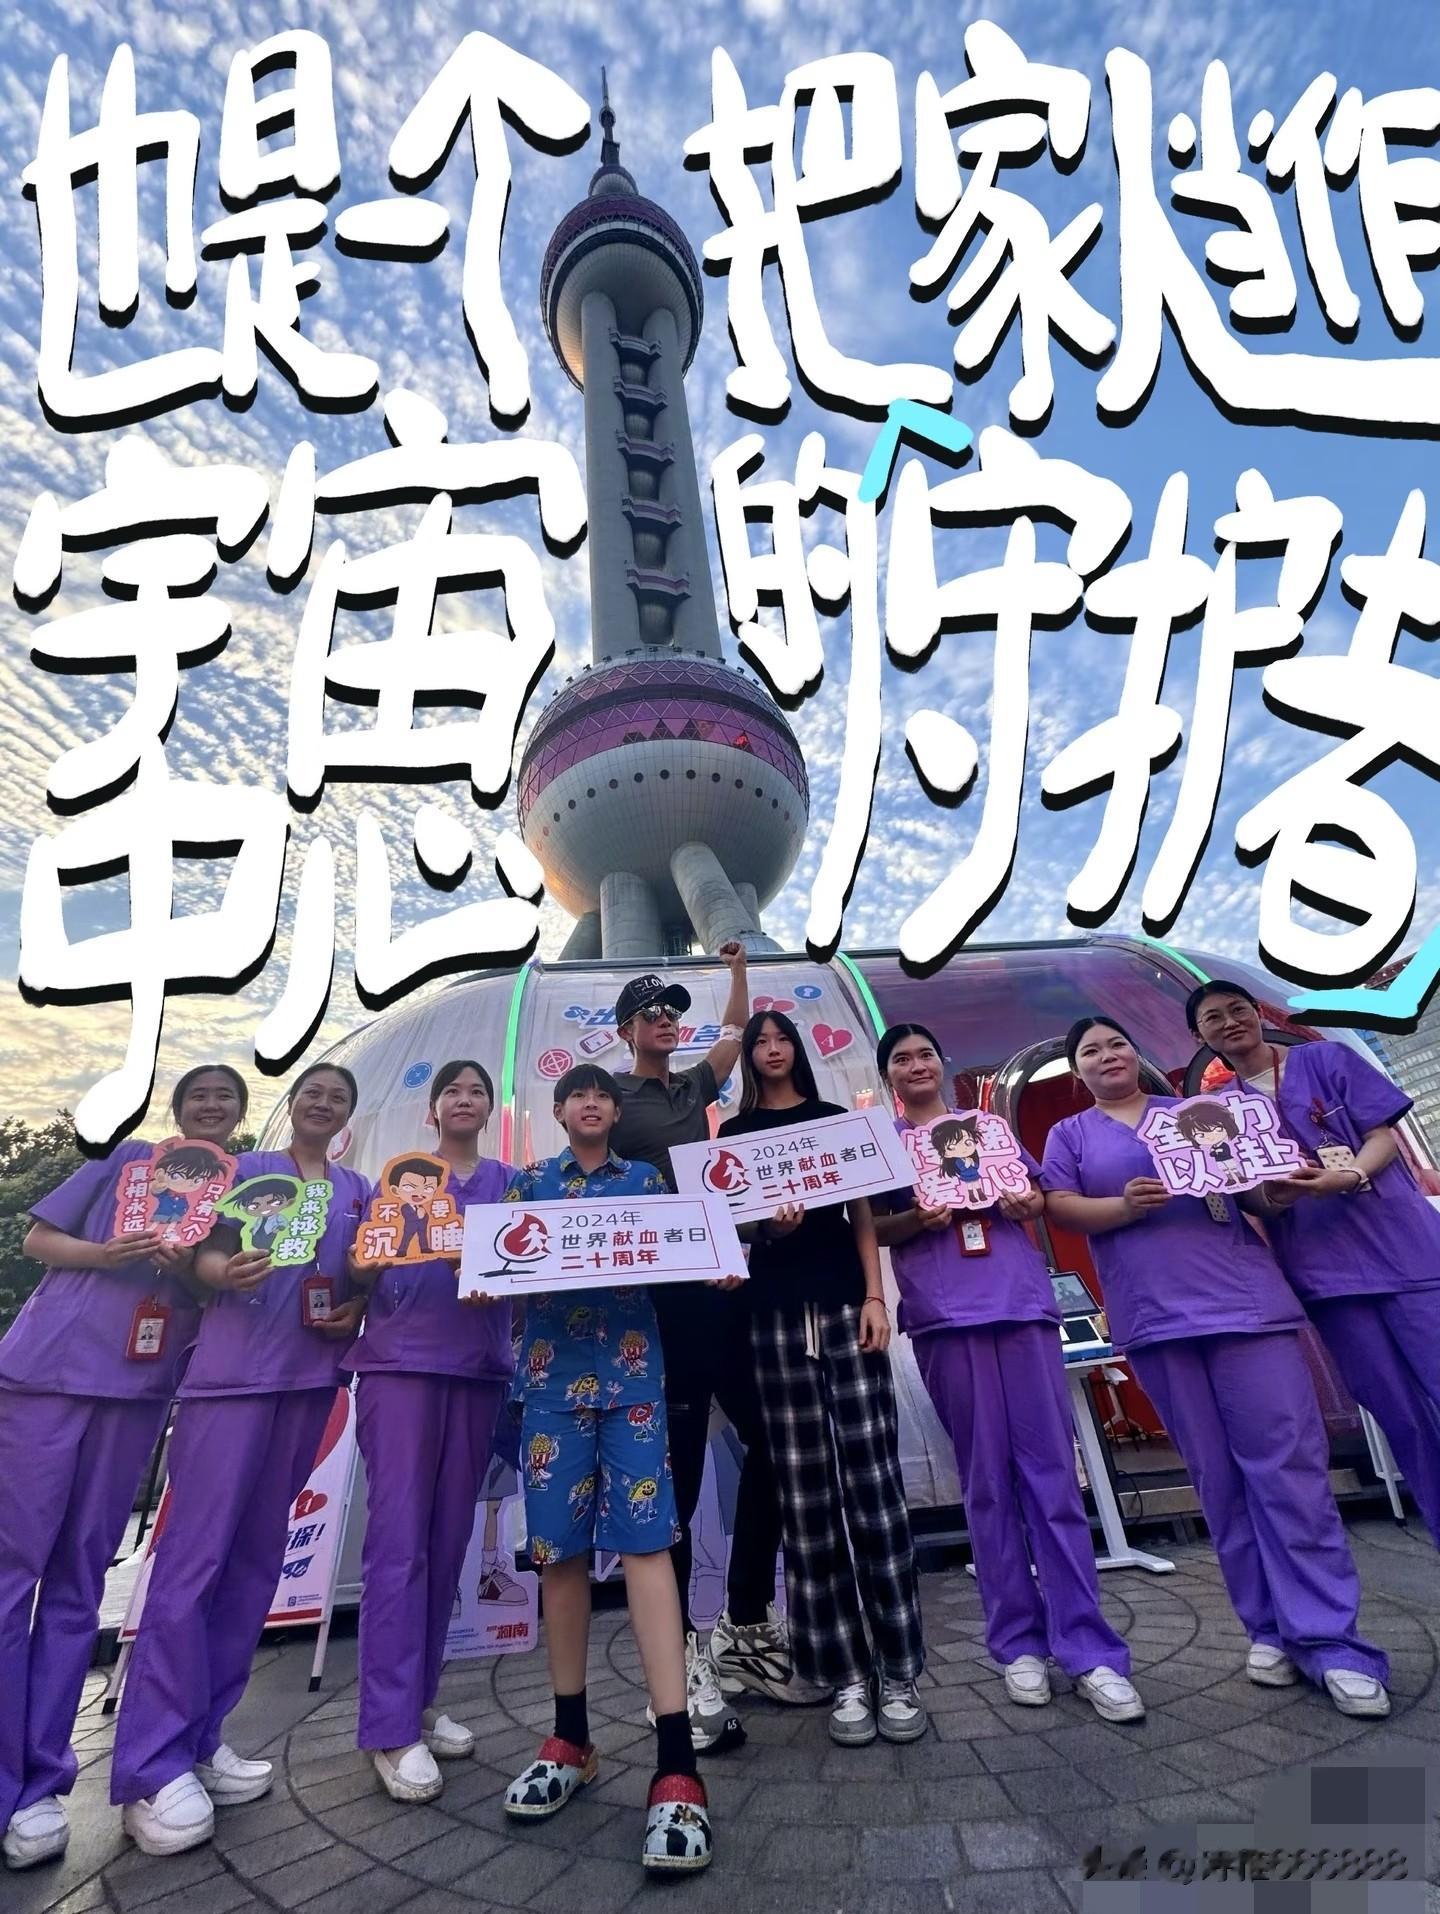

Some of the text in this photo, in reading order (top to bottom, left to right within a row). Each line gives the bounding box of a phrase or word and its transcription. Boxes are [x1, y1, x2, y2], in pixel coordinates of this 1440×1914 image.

[752, 1135, 820, 1161] 2024年
[756, 1142, 878, 1181] 世界献血者日
[123, 1165, 151, 1233] 真相永远
[761, 1170, 844, 1200] 二十周年
[181, 1182, 226, 1242] 只有一个
[277, 1183, 328, 1261] 我来拯救
[561, 1210, 643, 1229] 2024年
[561, 1227, 707, 1250] 世界献血者日
[561, 1249, 660, 1270] 二十周年
